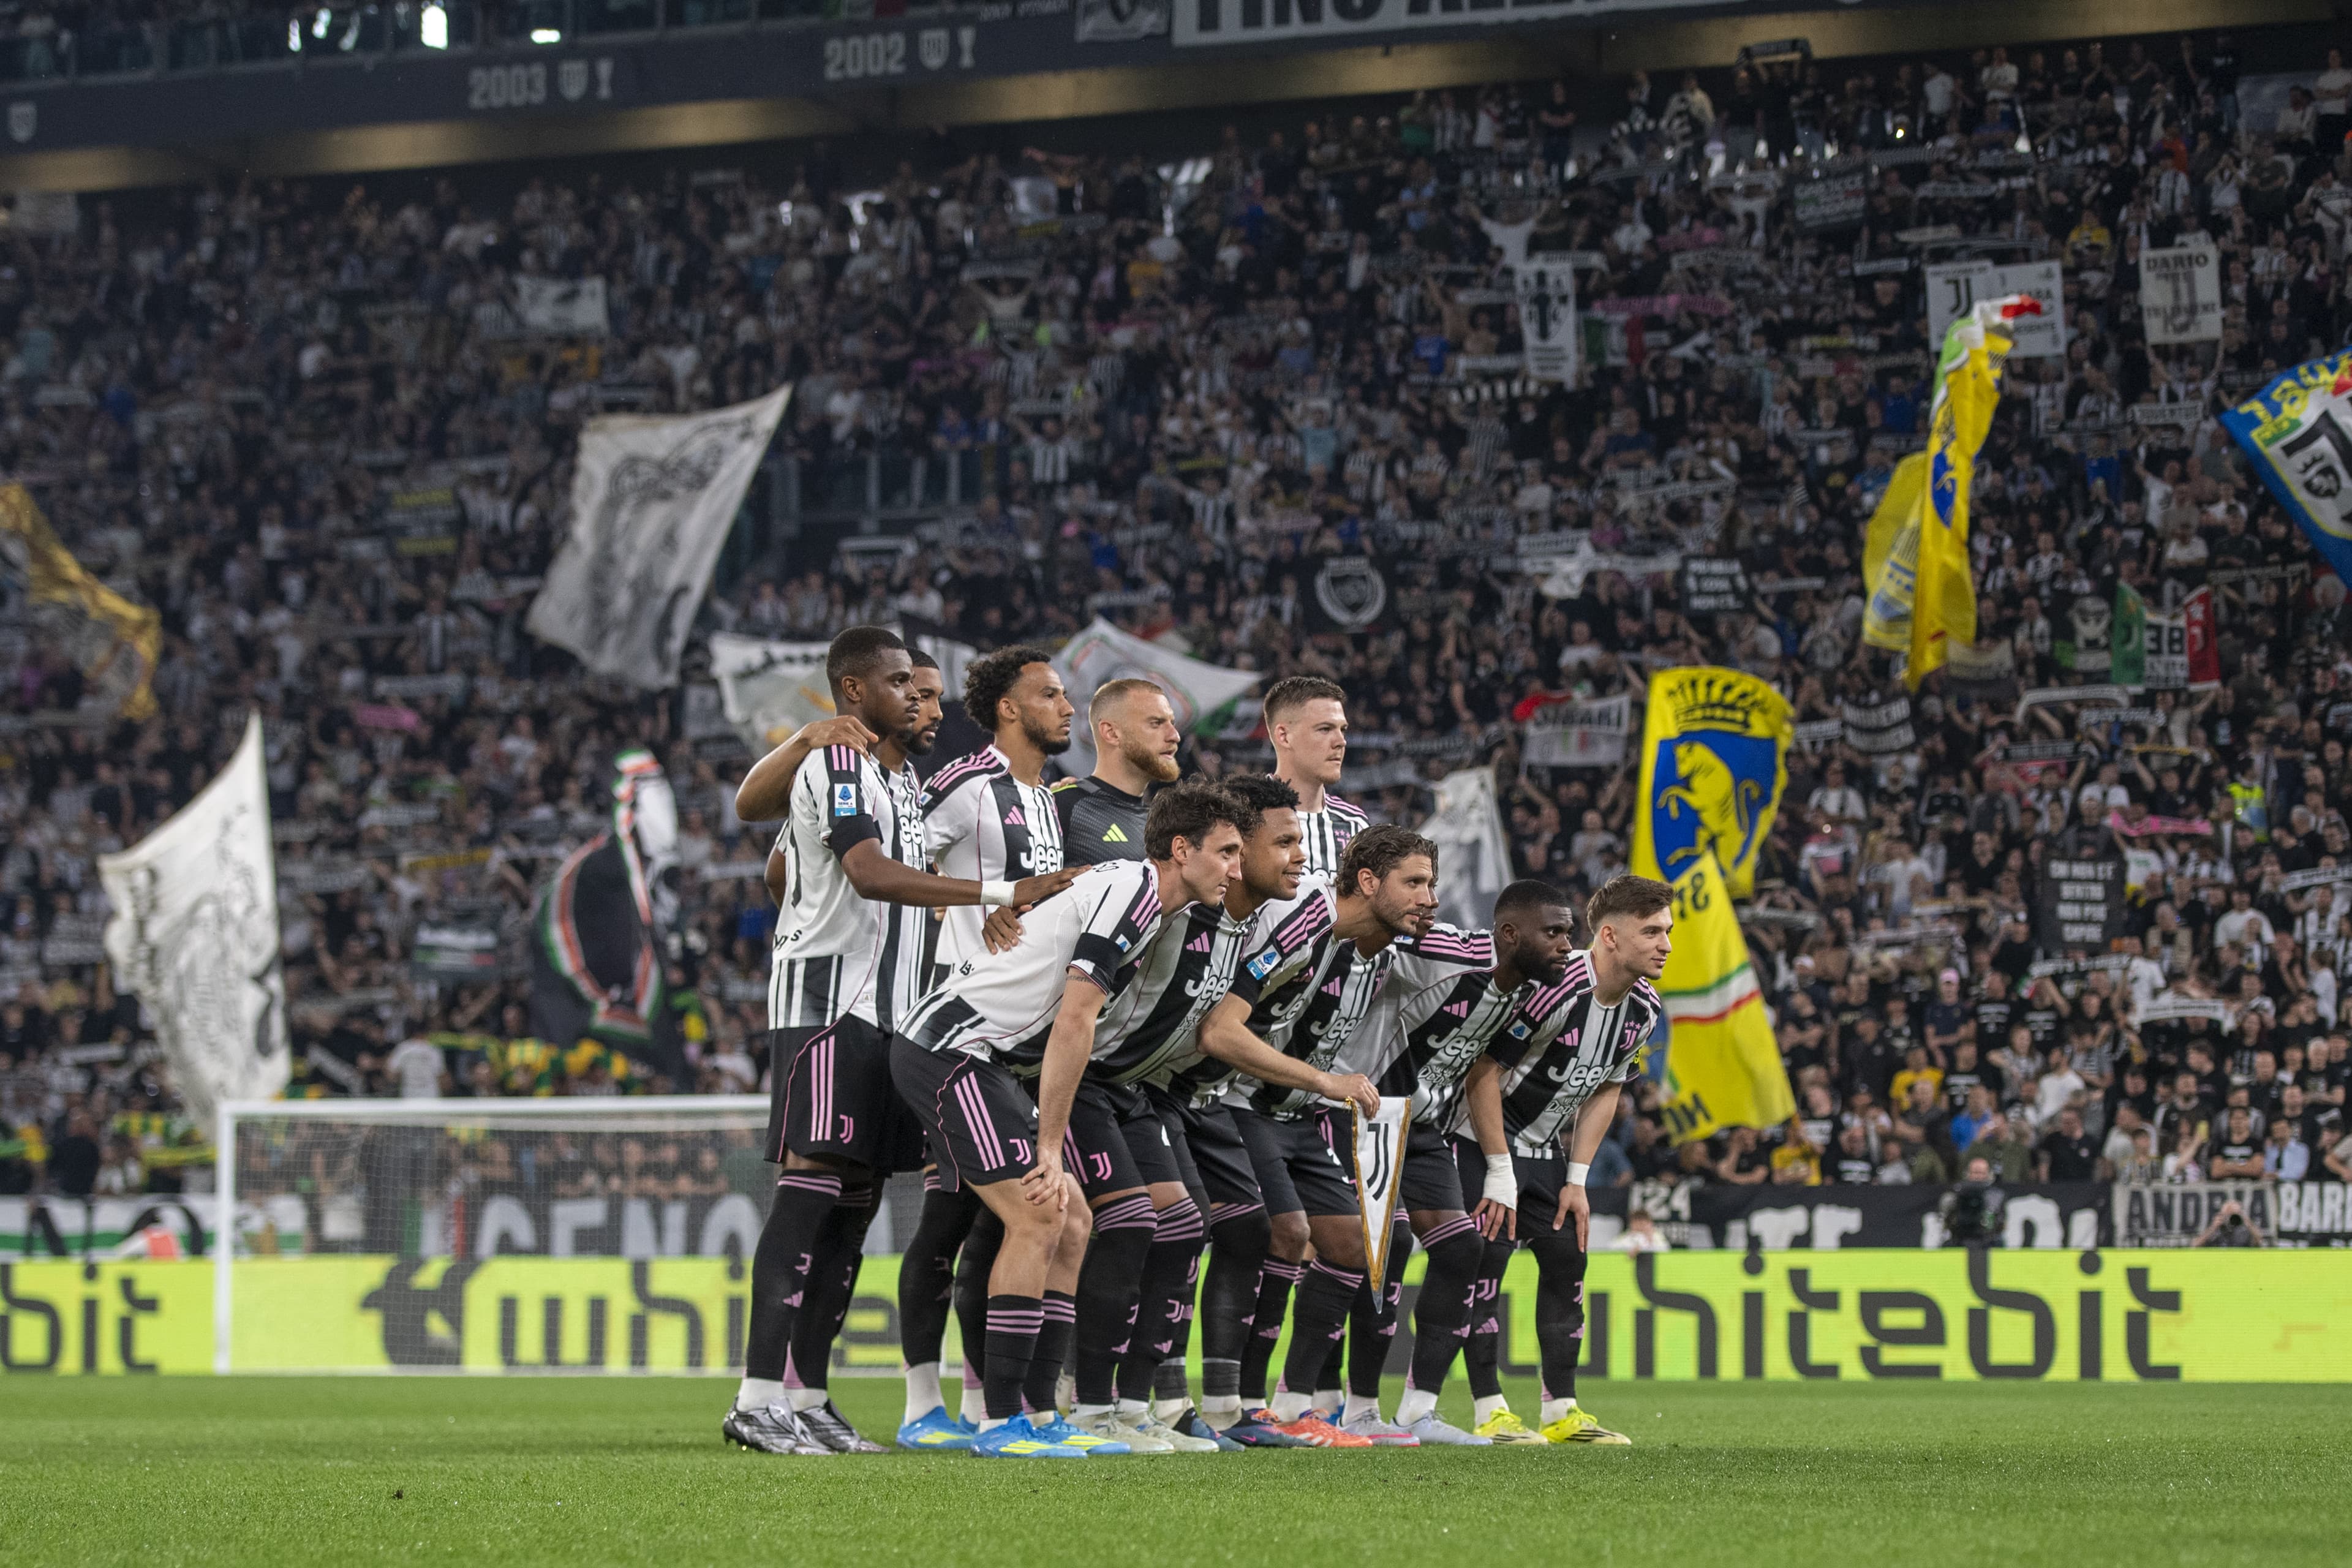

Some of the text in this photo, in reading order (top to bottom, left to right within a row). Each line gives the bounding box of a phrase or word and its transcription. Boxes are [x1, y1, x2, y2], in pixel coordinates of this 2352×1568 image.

[824, 32, 907, 81] 2002
[468, 63, 546, 110] 2003
[2146, 624, 2185, 655] 38
[1547, 1057, 1615, 1091] Jeep
